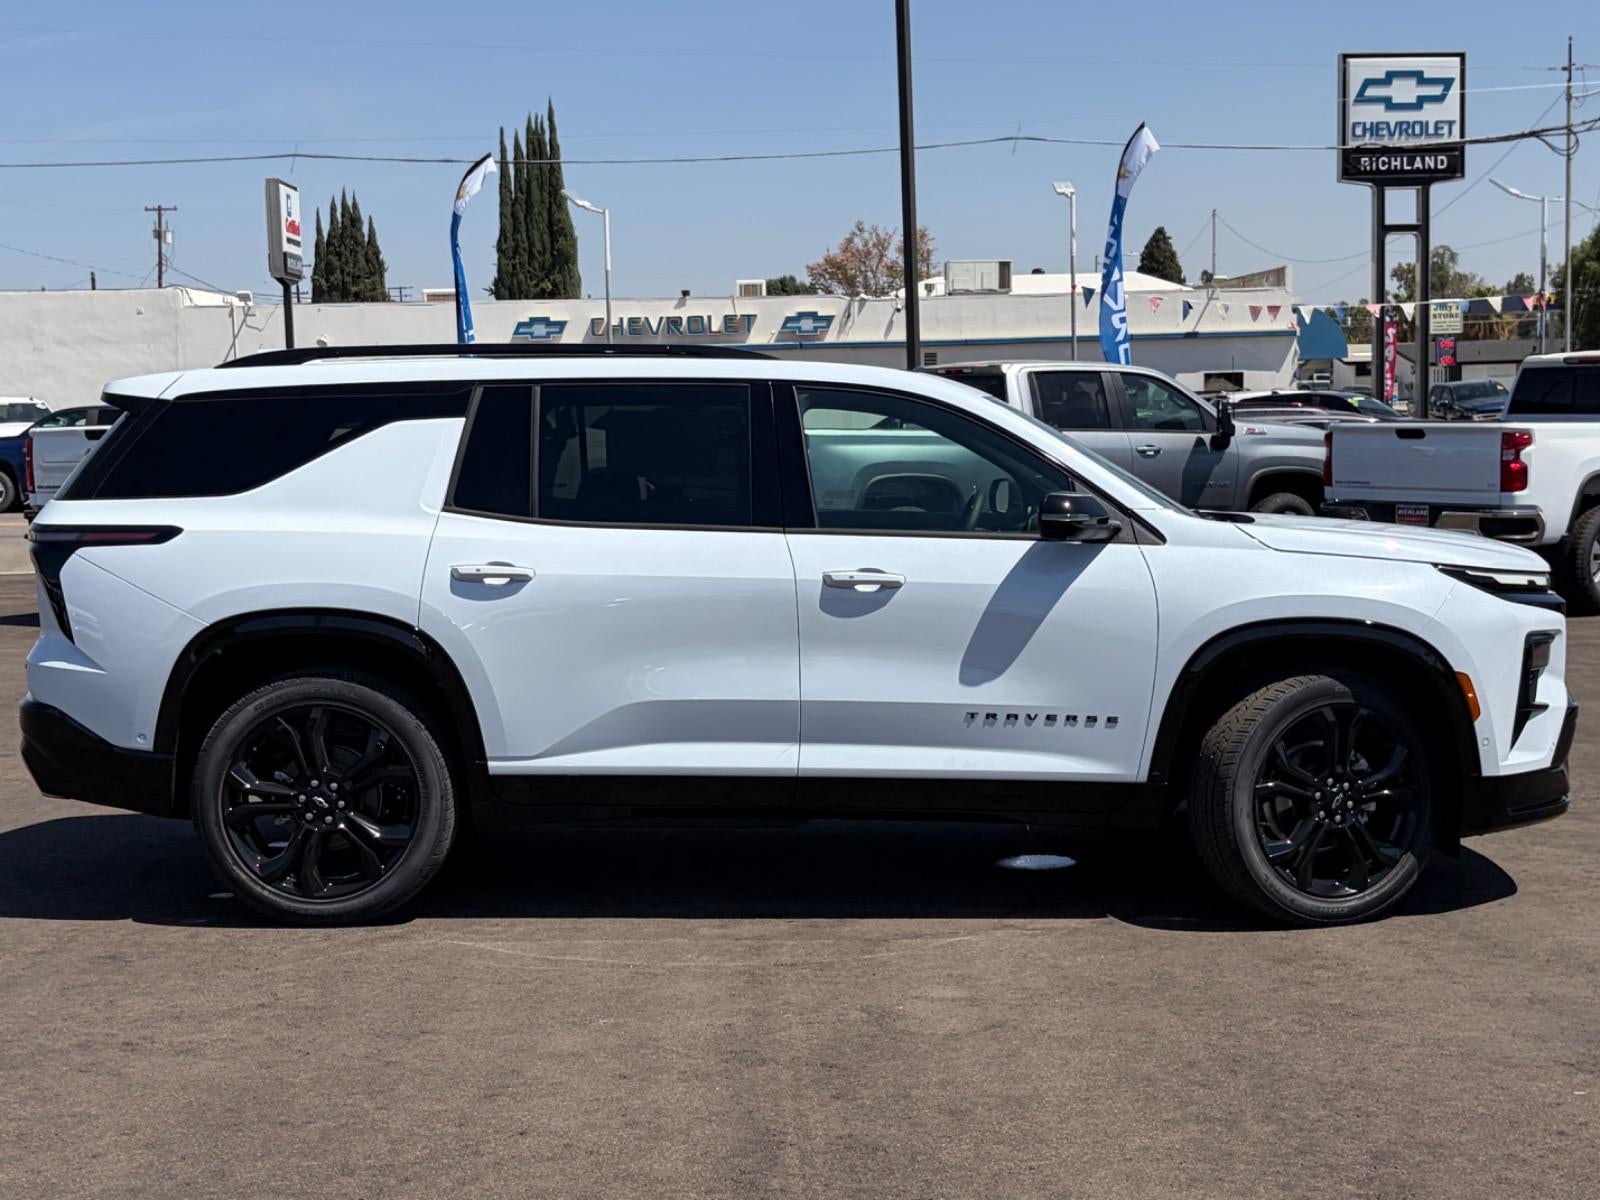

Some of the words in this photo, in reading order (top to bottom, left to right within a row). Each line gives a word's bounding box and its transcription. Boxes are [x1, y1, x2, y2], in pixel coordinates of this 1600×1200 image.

[1351, 120, 1456, 138] CHEVROLET
[1360, 155, 1448, 171] RICHLAND
[590, 314, 758, 336] CHEVROLET
[966, 711, 1119, 724] TRAVERSE
